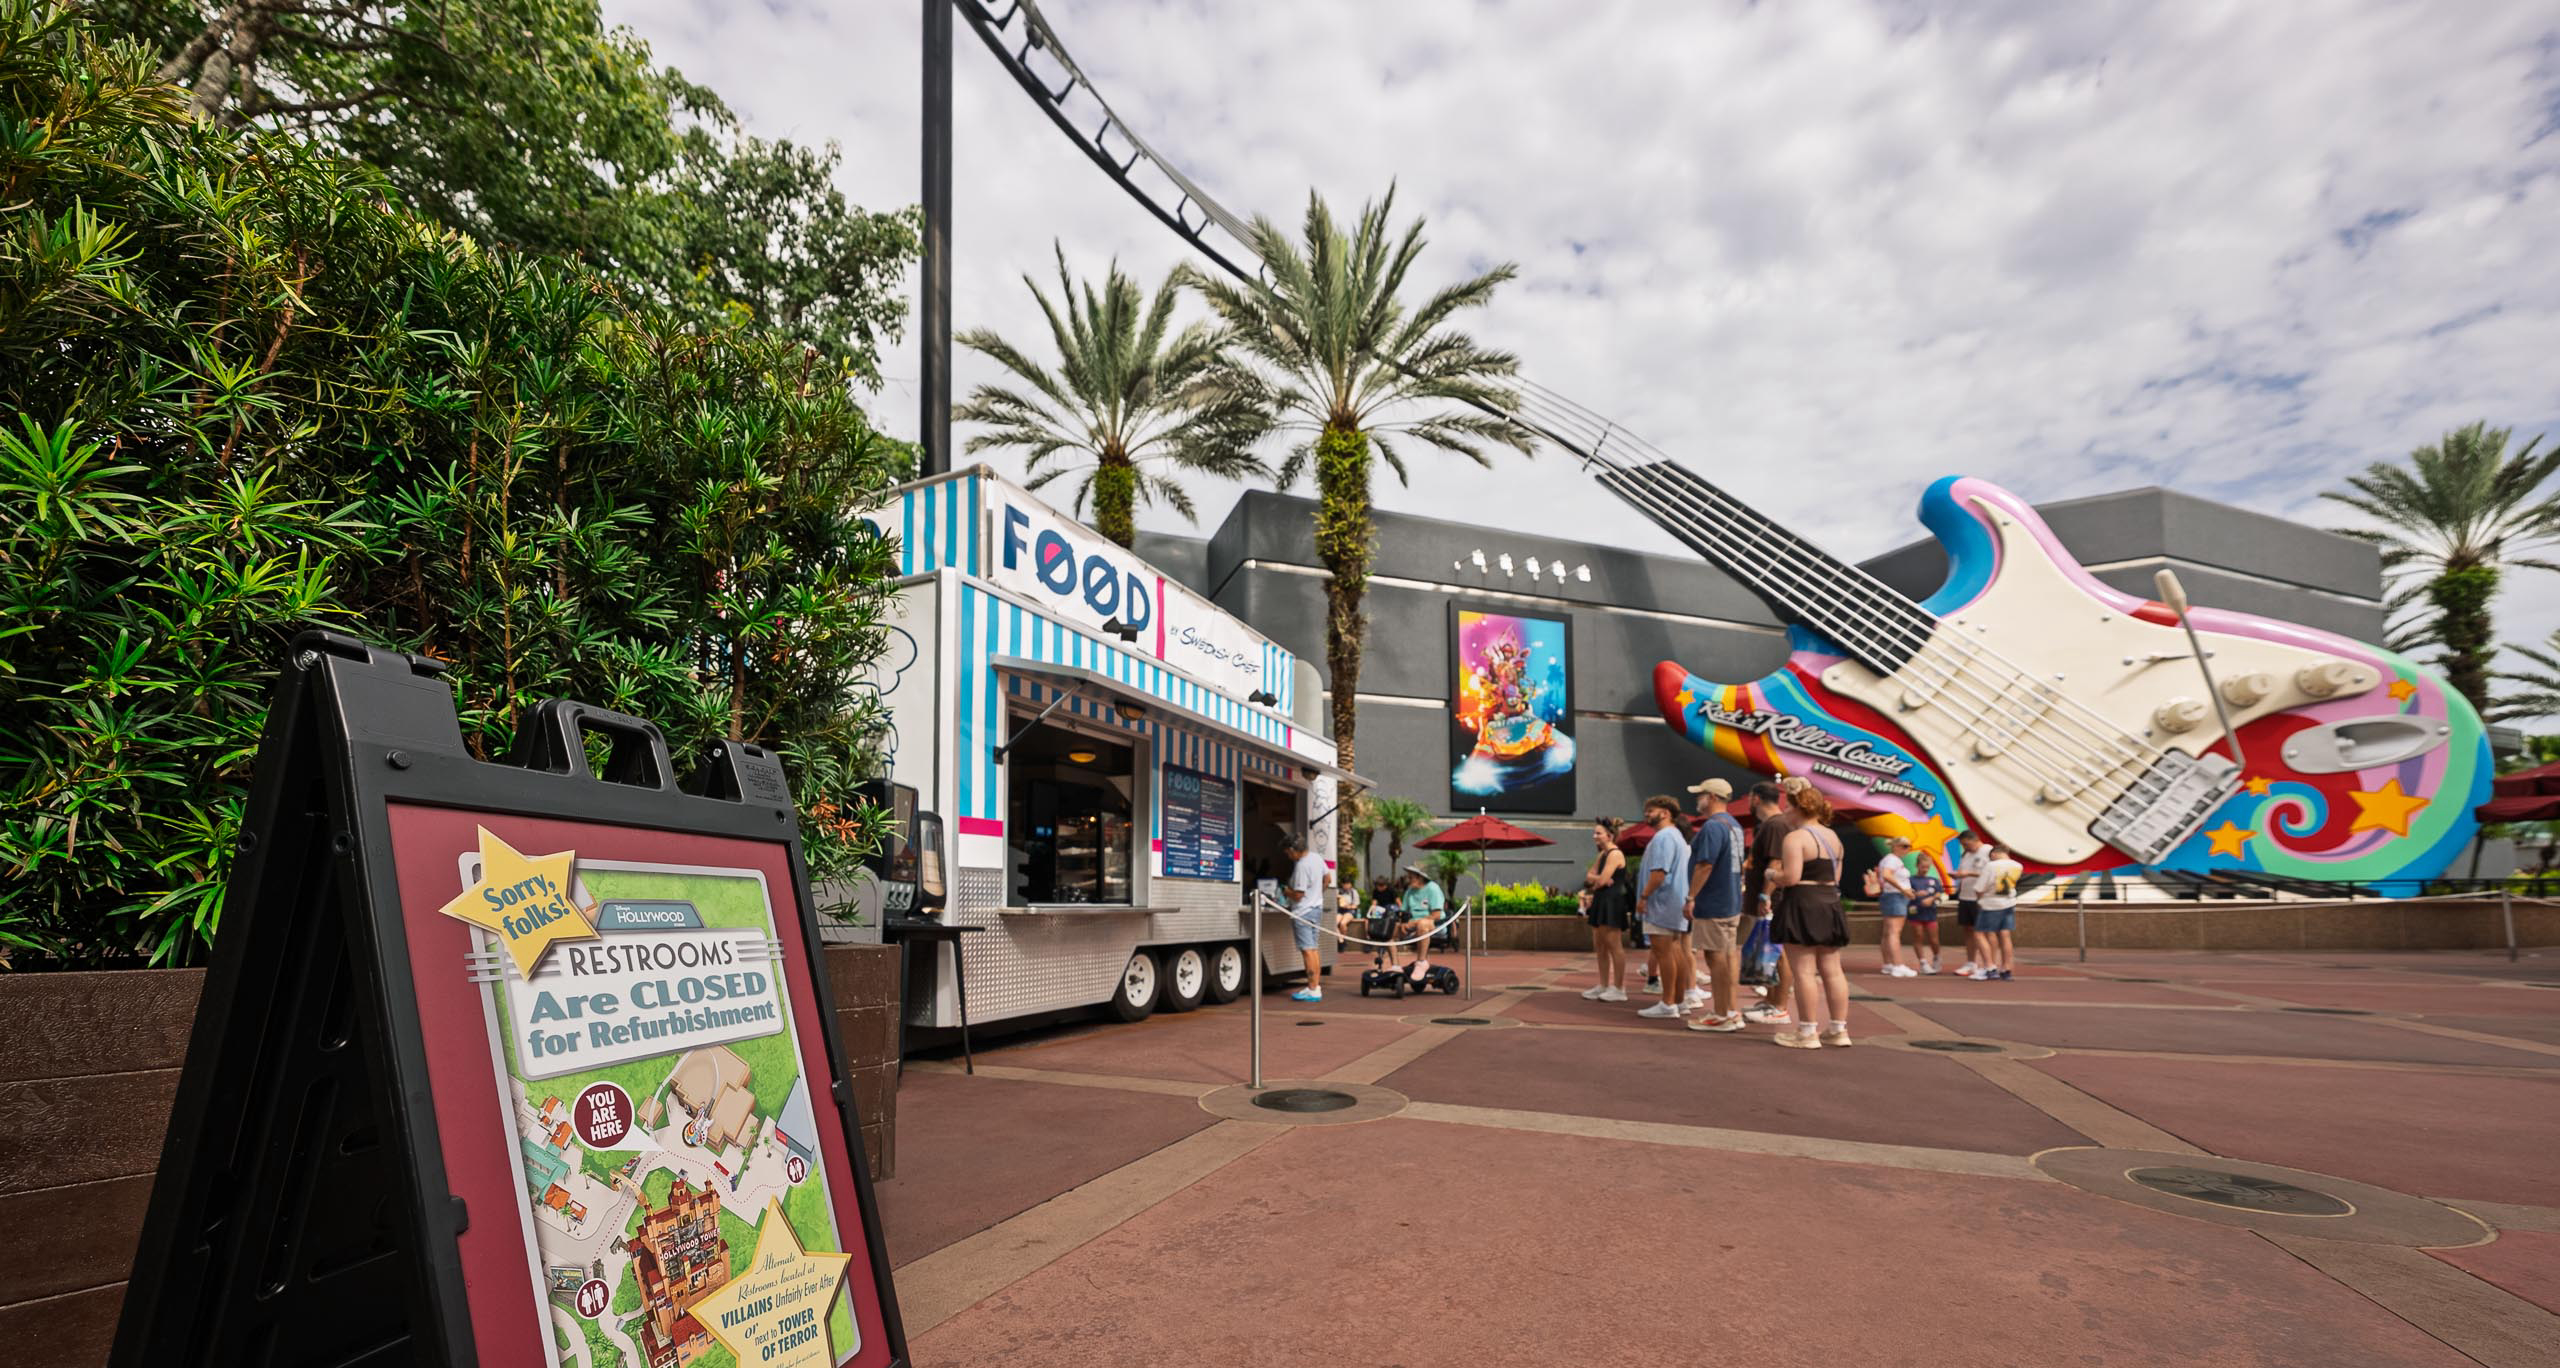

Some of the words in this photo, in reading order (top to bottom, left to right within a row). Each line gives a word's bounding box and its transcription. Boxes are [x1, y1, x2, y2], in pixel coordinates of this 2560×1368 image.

[1698, 700, 1744, 725] Rock
[1754, 709, 1842, 760] Roller
[1838, 741, 1913, 775] Coaster
[1813, 761, 1871, 785] STARRING
[483, 874, 556, 912] Sorry,
[502, 893, 570, 940] folks!
[617, 911, 684, 923] HOLLYWOOD
[569, 941, 733, 976] RESTROOMS
[530, 991, 619, 1024] Are
[630, 972, 767, 1010] CLOSED
[528, 1029, 581, 1058] for
[588, 1000, 776, 1048] Refurbishment
[585, 1090, 615, 1109] YOU
[592, 1105, 617, 1125] ARE
[590, 1120, 623, 1141] HERE
[659, 1238, 699, 1261] HOLLYWOOD
[755, 1252, 796, 1275] Alternate
[738, 1280, 778, 1302] Restrooms
[780, 1262, 807, 1284] located
[807, 1262, 816, 1274] at
[721, 1296, 773, 1329] VILLAINS
[775, 1284, 803, 1308] Unfairly
[804, 1282, 818, 1297] Ever
[819, 1273, 835, 1291] After
[744, 1322, 759, 1339] or
[778, 1308, 815, 1335] TOWER
[755, 1332, 770, 1346] next
[770, 1328, 778, 1339] to
[762, 1341, 775, 1362] OF
[778, 1324, 818, 1355] TERROR
